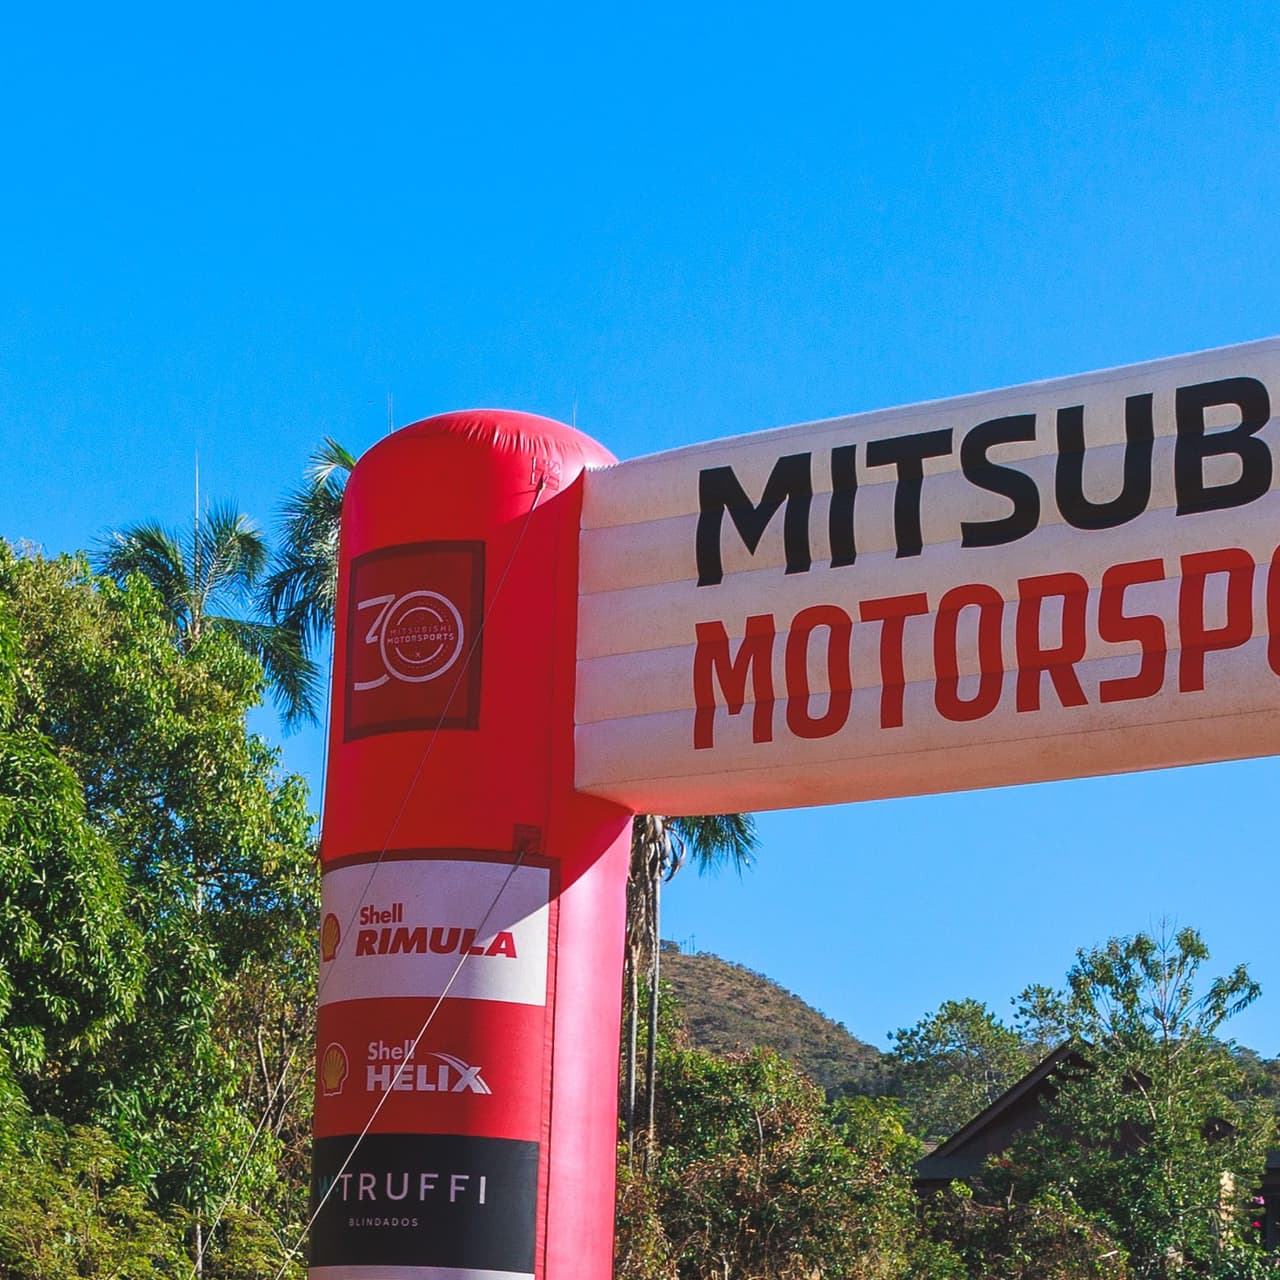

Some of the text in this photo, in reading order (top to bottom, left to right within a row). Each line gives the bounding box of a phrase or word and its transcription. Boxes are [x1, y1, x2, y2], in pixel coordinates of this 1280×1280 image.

[386, 633, 455, 645] MOTORSPORTS
[360, 903, 403, 925] Shell
[355, 927, 517, 959] RIMULA
[367, 1040, 415, 1060] Shell
[367, 1060, 492, 1094] HELIX
[348, 1217, 418, 1228] BLINDADOS
